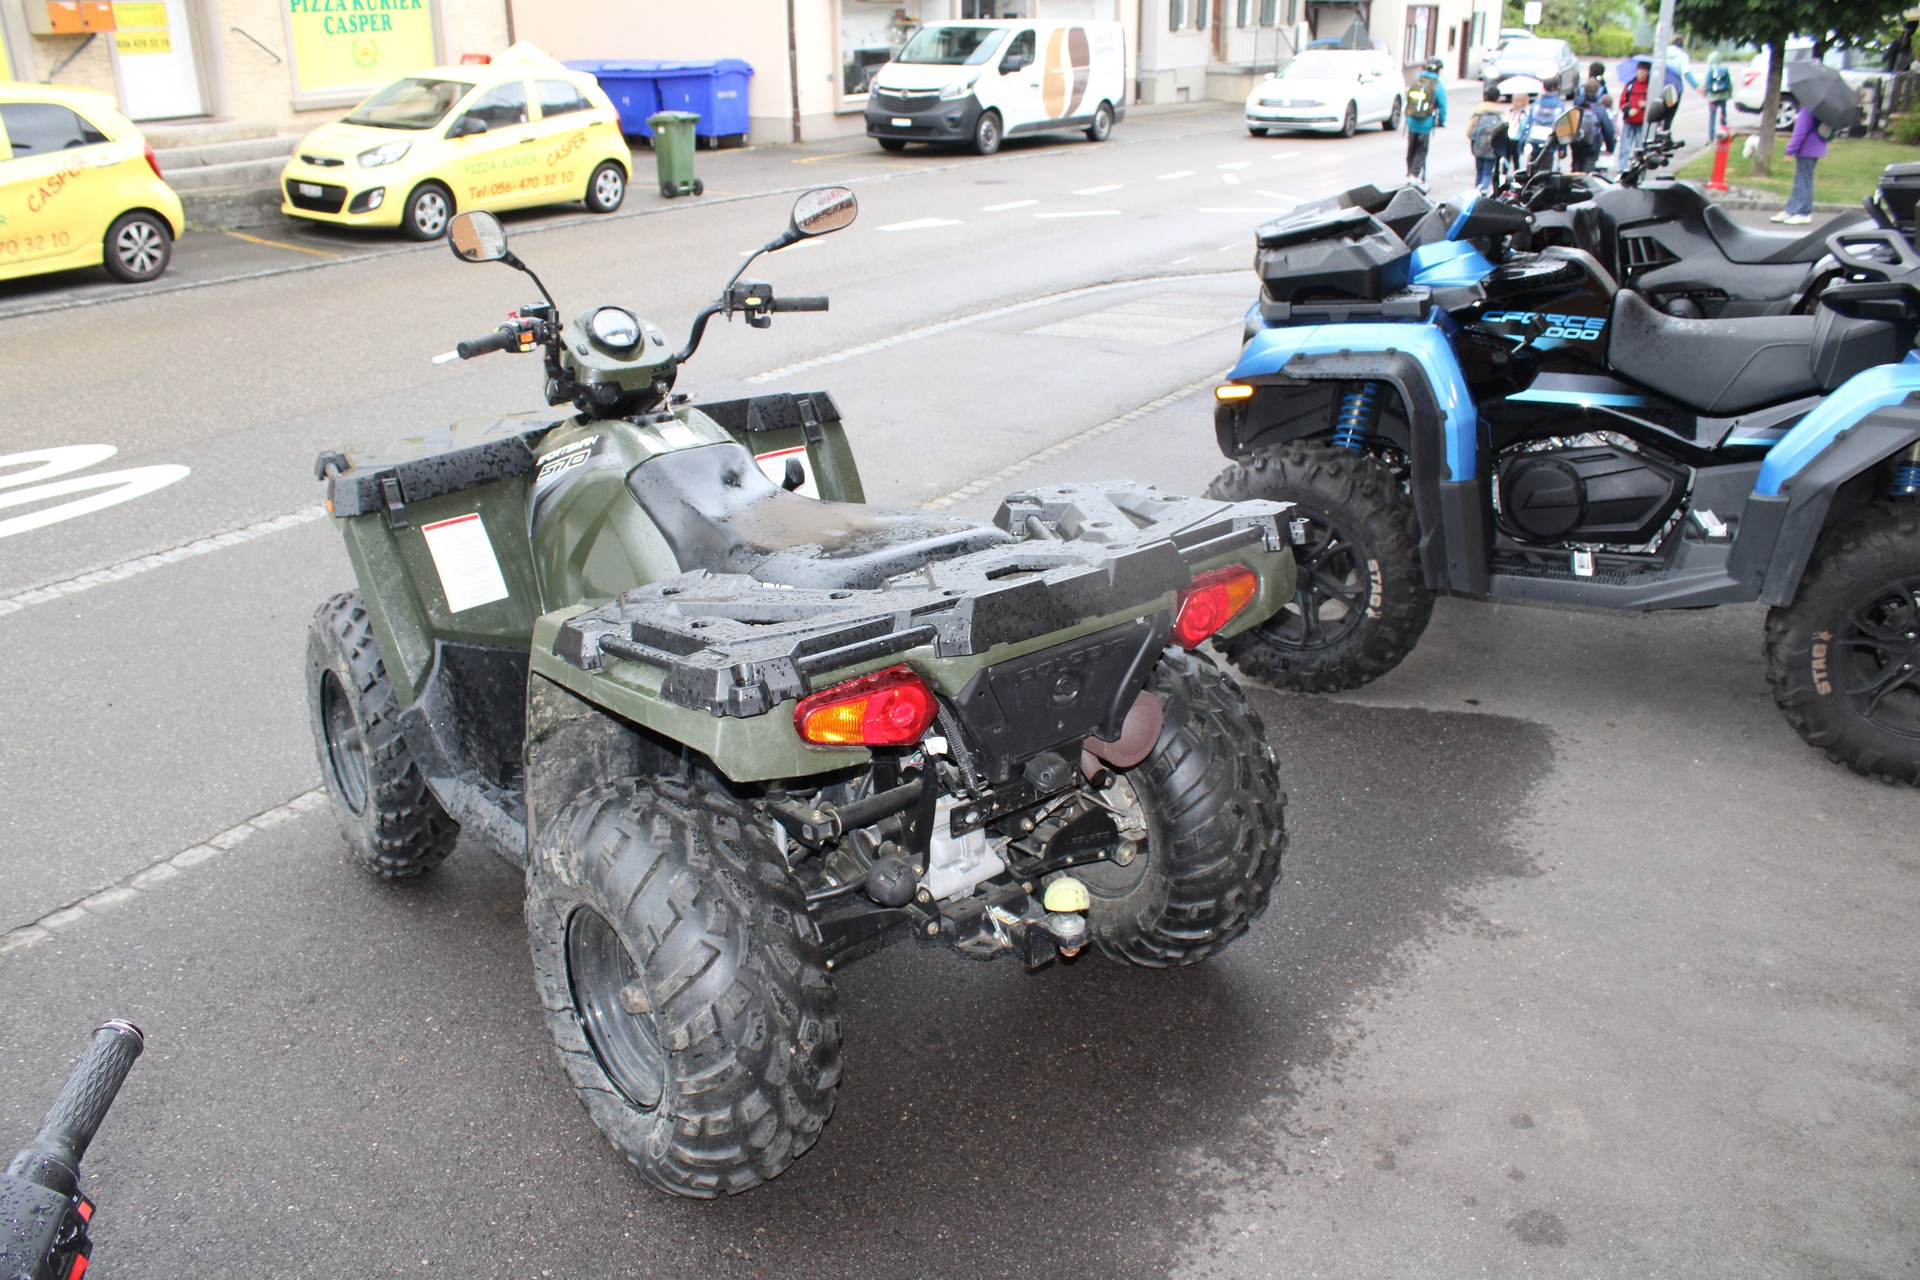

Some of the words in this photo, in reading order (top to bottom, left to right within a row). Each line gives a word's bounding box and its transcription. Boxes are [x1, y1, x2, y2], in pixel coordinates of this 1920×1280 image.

[324, 14, 392, 35] CASPER
[547, 132, 587, 167] CASPER
[27, 154, 88, 212] CASPER
[544, 174, 556, 187] 32
[561, 170, 574, 184] 10
[24, 236, 46, 252] 32
[51, 230, 70, 247] 10
[1367, 559, 1383, 608] STAG
[1812, 643, 1832, 695] STAG
